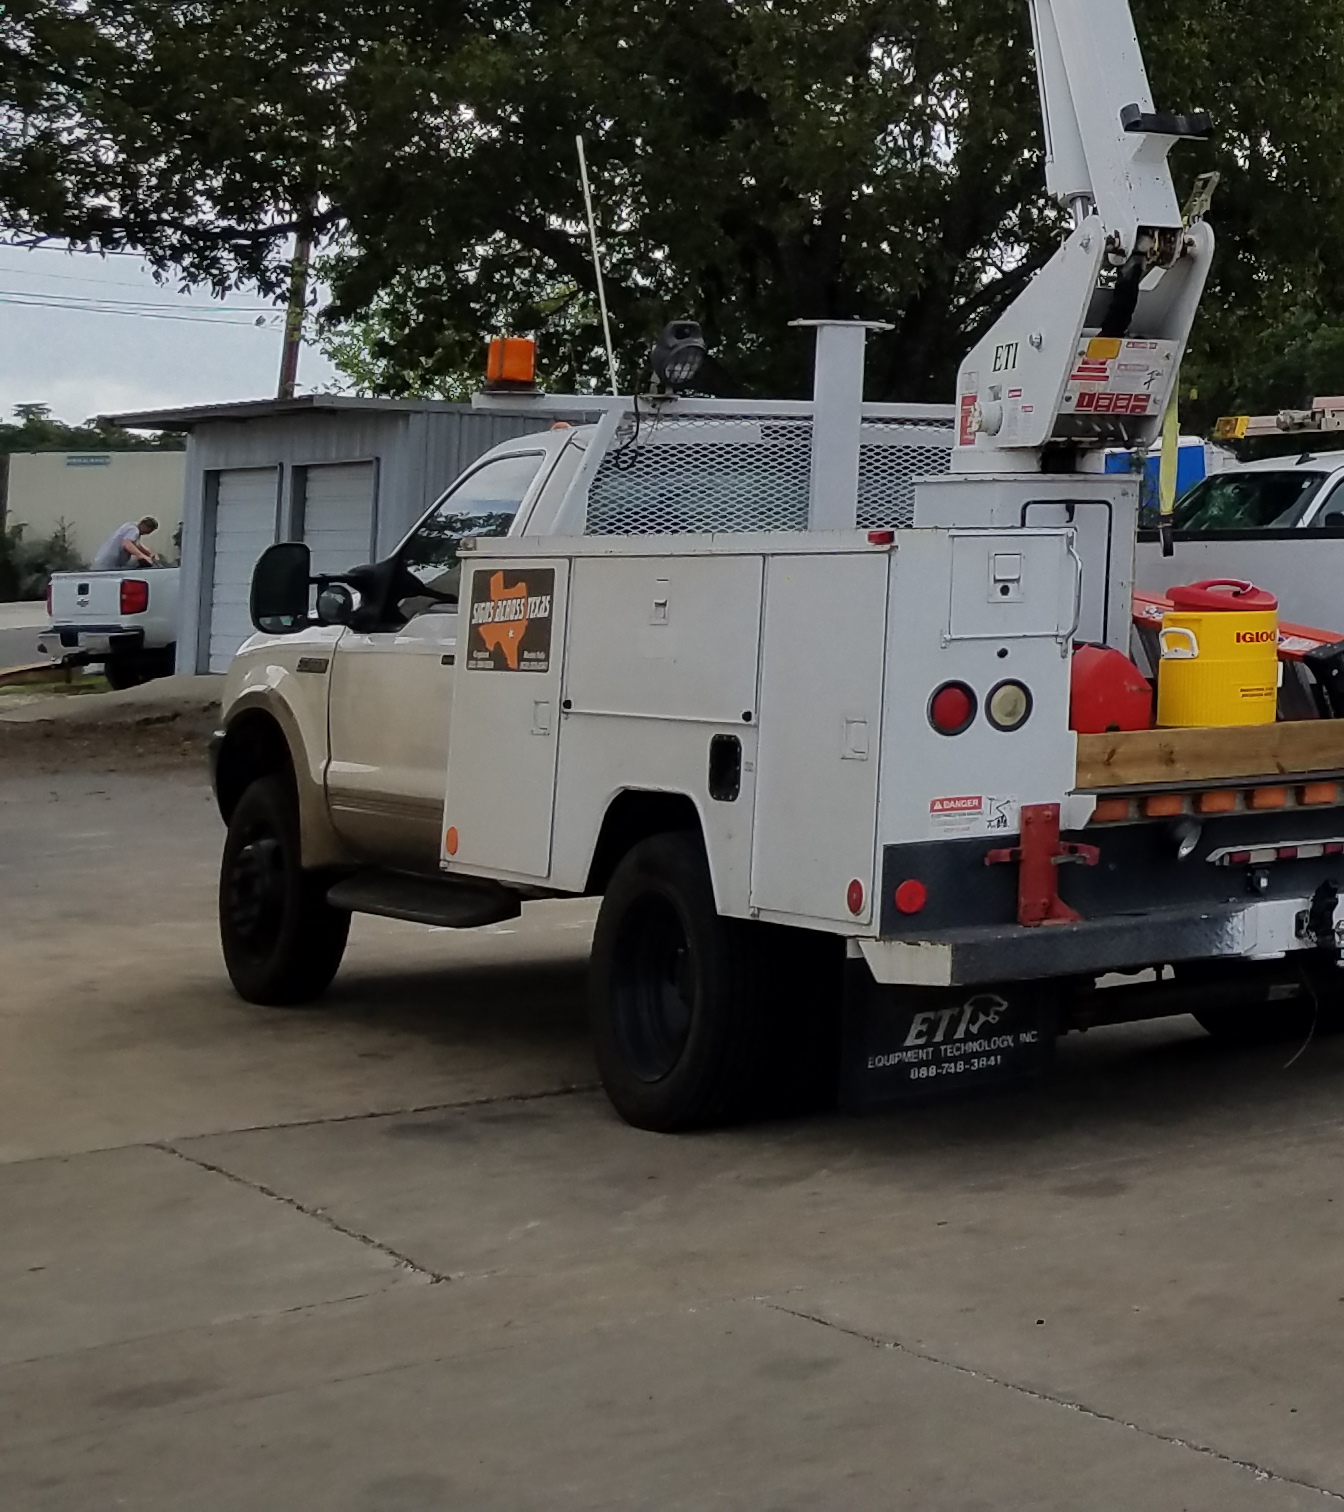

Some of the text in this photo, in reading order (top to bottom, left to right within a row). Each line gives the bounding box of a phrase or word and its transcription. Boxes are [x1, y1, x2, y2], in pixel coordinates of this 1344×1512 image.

[992, 343, 1019, 372] ETI
[1236, 632, 1276, 643] IGLOO
[943, 799, 979, 809] DANGER
[904, 1005, 974, 1046] ETI
[868, 1048, 934, 1069] EQUIPMENT
